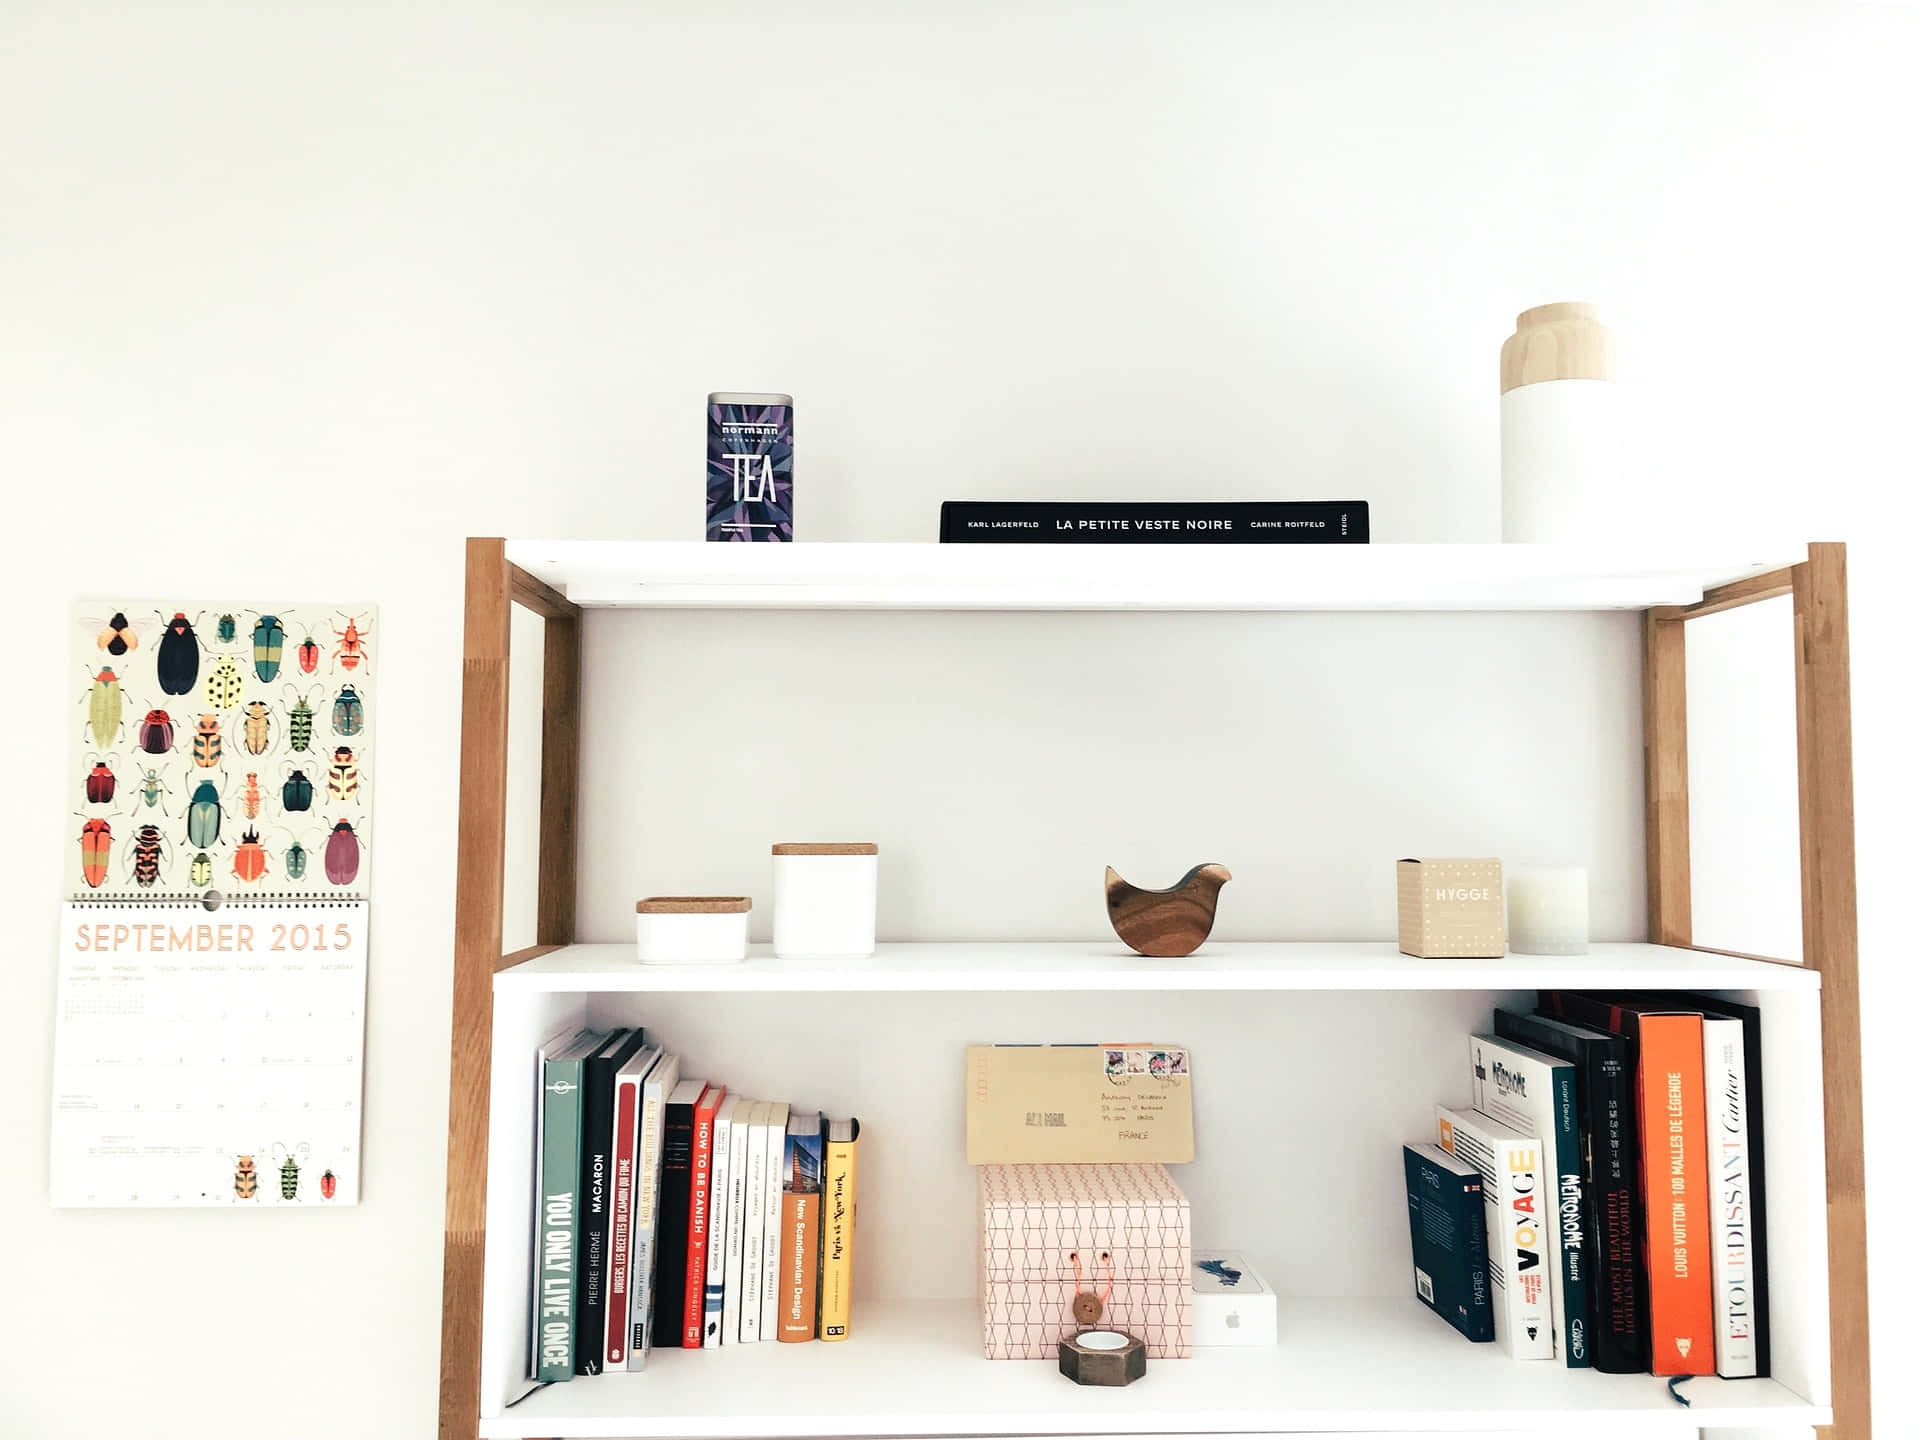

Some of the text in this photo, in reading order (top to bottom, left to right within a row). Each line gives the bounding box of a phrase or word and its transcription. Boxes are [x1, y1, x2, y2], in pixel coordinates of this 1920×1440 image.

[722, 427, 778, 435] normann
[722, 454, 777, 502] TEA
[1056, 520, 1233, 530] LA PETITE VESTE NOIRE
[1435, 887, 1489, 901] HYGGE
[75, 923, 352, 952] SEPTEMBER 2015
[1721, 1069, 1741, 1134] Cartier
[699, 1122, 708, 1149] HOW
[1118, 1131, 1149, 1141] FRANCE
[618, 1159, 631, 1176] FUME
[697, 1153, 707, 1168] TO
[592, 1154, 604, 1213] MACARON
[1666, 1072, 1688, 1278] LOUIS VUITTON 100 MALLES DE LÉGENDE
[617, 1188, 629, 1213] CAMION
[694, 1190, 705, 1233] DANISH
[797, 1200, 806, 1220] New
[833, 1203, 845, 1222] New
[1619, 1189, 1631, 1237] WORLD
[617, 1213, 628, 1222] DU
[1607, 1192, 1621, 1261] BEAUTIFUL
[615, 1224, 628, 1252] RECETTES
[832, 1237, 842, 1260] Paris
[1722, 1137, 1748, 1338] ETOURDISSANT
[615, 1252, 627, 1265] LES
[795, 1222, 806, 1285] Scandinavian
[1622, 1239, 1632, 1265] THE
[542, 1192, 573, 1368] YOU ONLY LIVE ONCE
[588, 1231, 601, 1305] PIERRE HERMÉ
[1623, 1268, 1633, 1282] IN
[1472, 1271, 1485, 1305] PARIS
[1610, 1266, 1623, 1303] MOST
[792, 1287, 803, 1320] Design
[1612, 1304, 1625, 1334] THE
